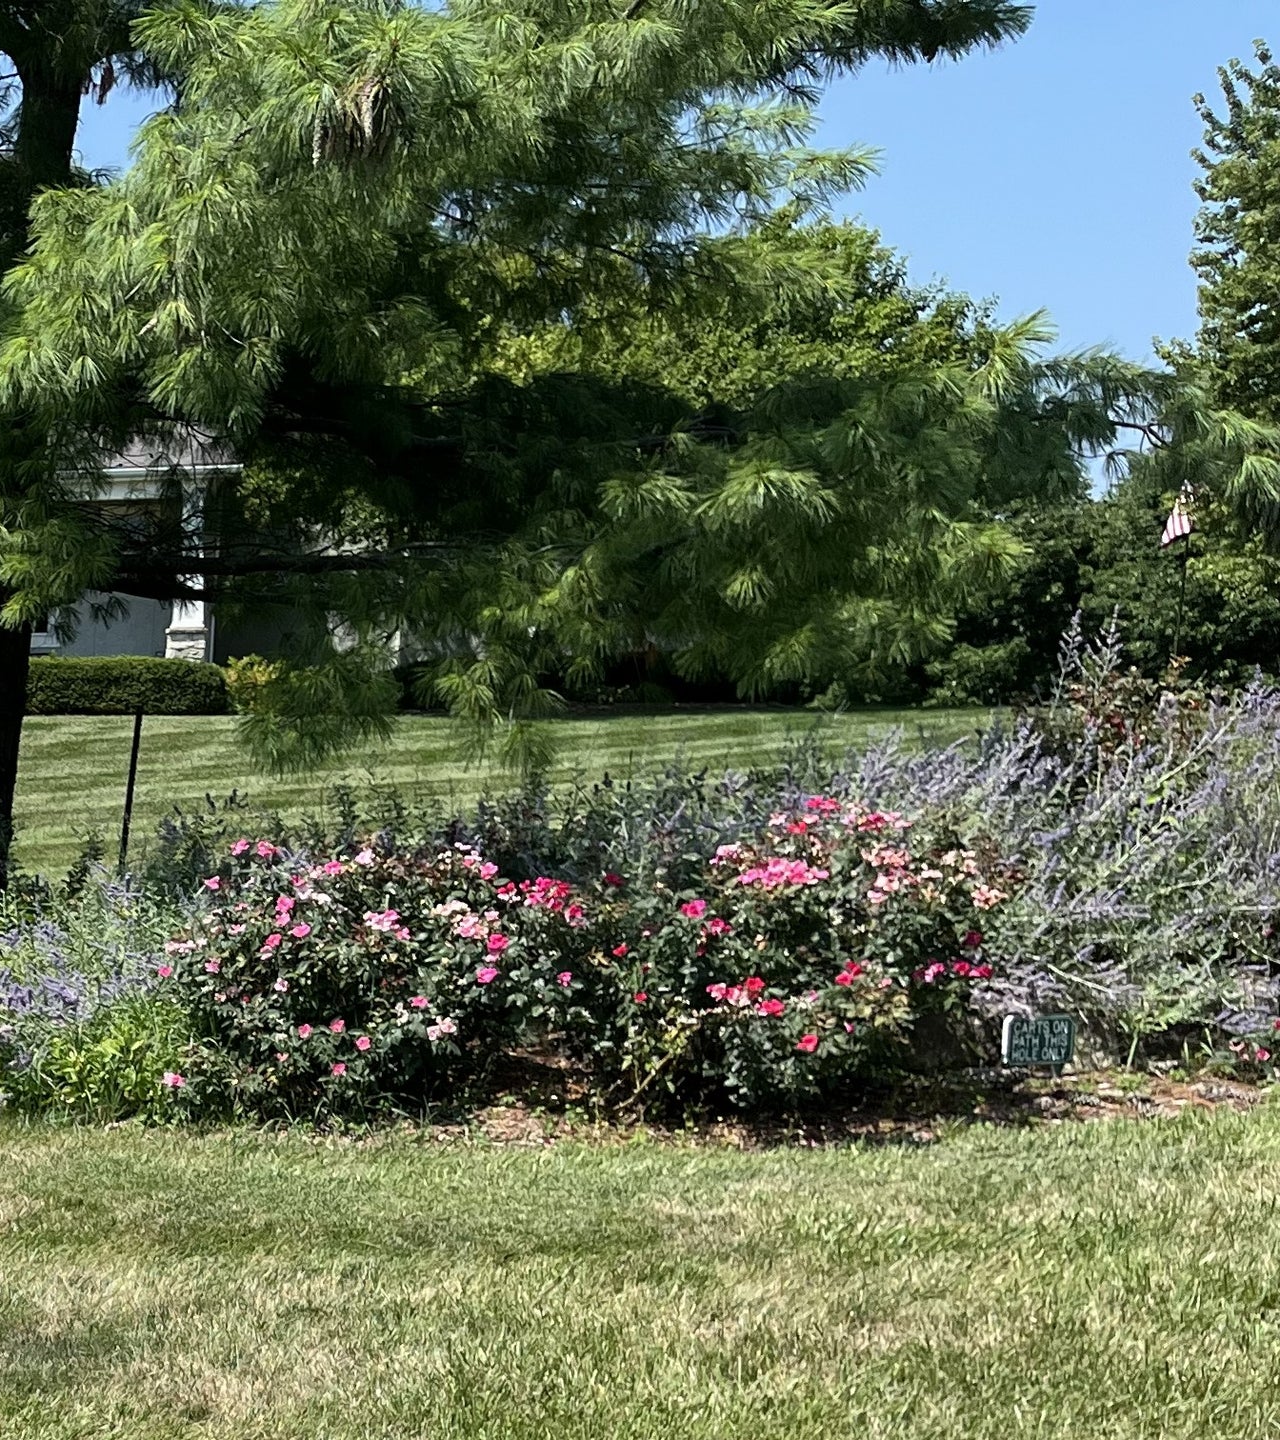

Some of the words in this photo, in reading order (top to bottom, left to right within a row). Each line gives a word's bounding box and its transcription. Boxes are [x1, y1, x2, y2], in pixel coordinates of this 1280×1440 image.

[1013, 1020, 1050, 1034] CARTS
[1053, 1020, 1069, 1034] ON
[1012, 1033, 1040, 1048] PATH
[1044, 1033, 1068, 1047] THIS
[1011, 1047, 1039, 1061] HOLE
[1041, 1046, 1066, 1061] ONLY
